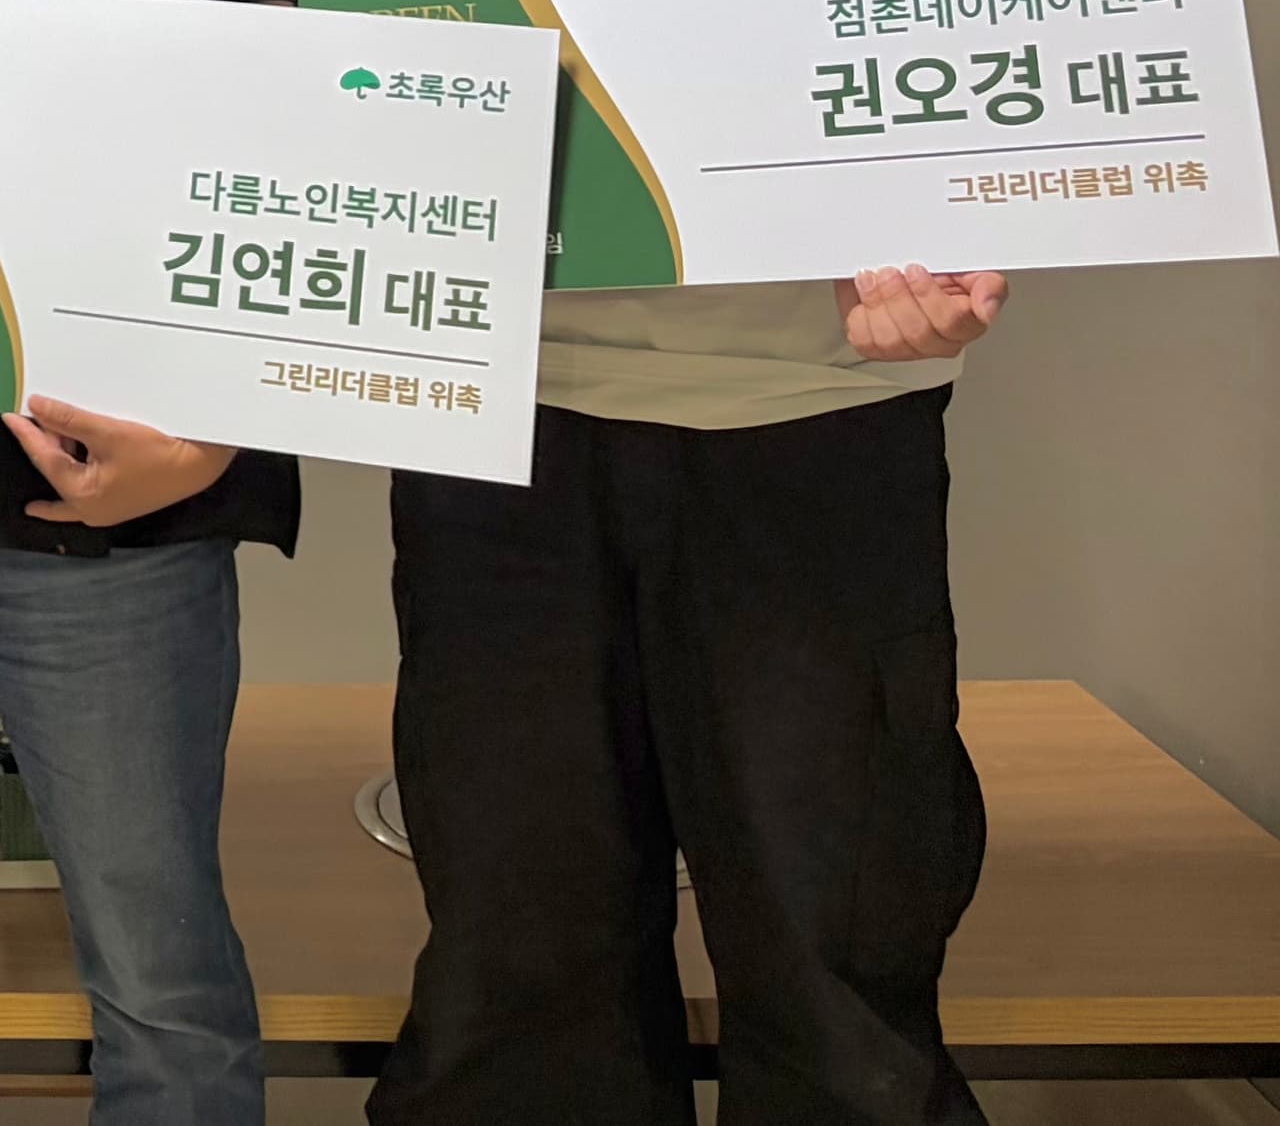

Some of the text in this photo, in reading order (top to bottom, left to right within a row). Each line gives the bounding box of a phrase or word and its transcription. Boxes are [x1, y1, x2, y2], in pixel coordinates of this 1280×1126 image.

[385, 71, 511, 113] 초록우산
[810, 44, 1200, 137] 권오경 대표
[189, 170, 498, 241] 다름노인복지센터
[947, 160, 1209, 204] 그린리더클럽 위촉
[162, 231, 493, 332] 김연희 대표
[260, 360, 483, 414] 그린리더클럽 위촉
